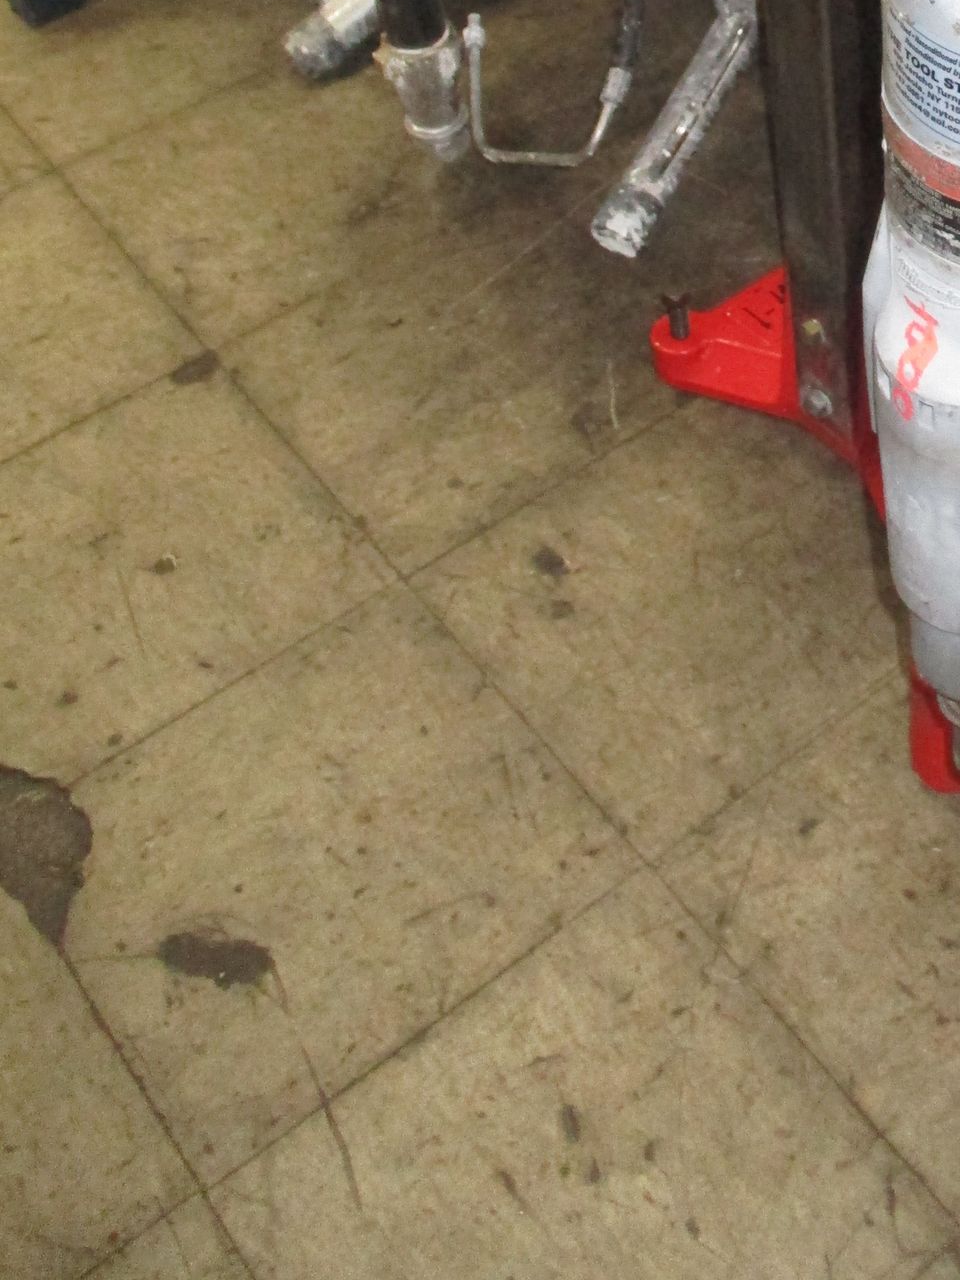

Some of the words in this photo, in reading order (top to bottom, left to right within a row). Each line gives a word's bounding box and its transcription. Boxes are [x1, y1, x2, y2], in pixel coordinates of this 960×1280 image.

[904, 49, 940, 83] TOOL
[904, 64, 934, 90] Jericho
[927, 91, 942, 103] NY
